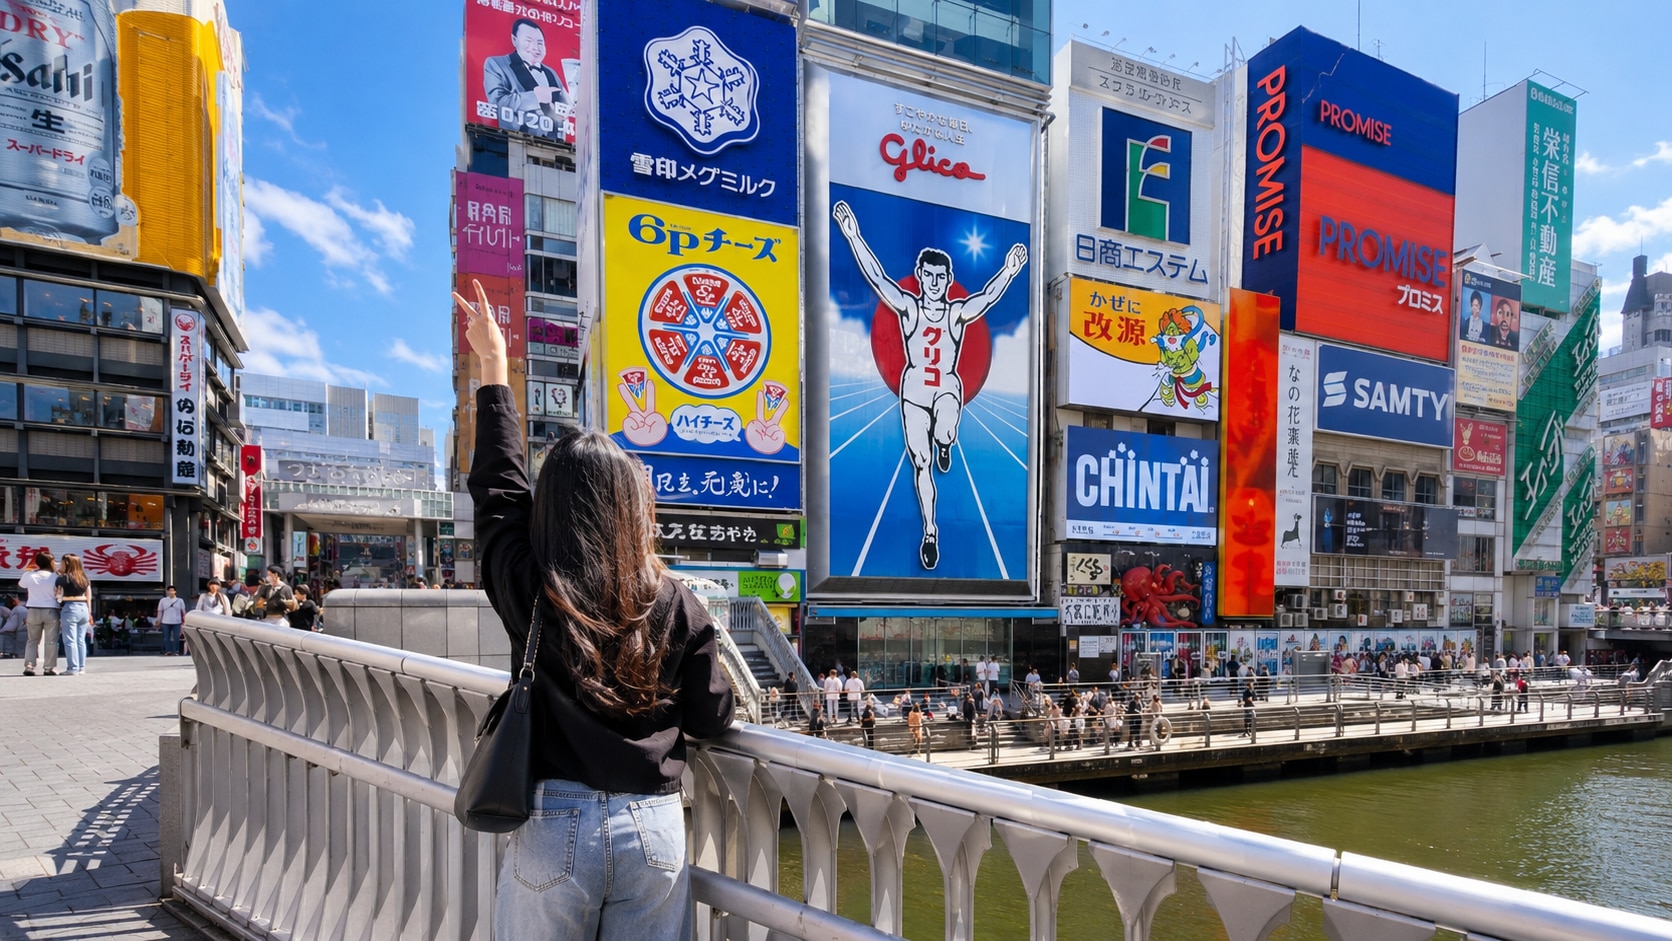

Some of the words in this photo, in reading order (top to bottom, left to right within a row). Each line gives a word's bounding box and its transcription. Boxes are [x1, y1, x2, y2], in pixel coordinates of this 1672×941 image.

[0, 10, 74, 50] DRY
[31, 108, 65, 134] 生
[1320, 99, 1392, 147] PROMISE
[6, 138, 86, 166] スーパードライ
[879, 133, 986, 182] Glico
[1253, 64, 1286, 260] PROMISE
[630, 152, 776, 198] 雪印メグミルク
[1076, 234, 1209, 285] 日商エステム
[1319, 215, 1448, 288] PROMISE
[1089, 291, 1141, 315] かぜに
[1397, 284, 1444, 315] プロミス
[1083, 311, 1147, 347] 改源
[922, 325, 946, 387] グリコ
[1354, 377, 1449, 421] SAMTY
[676, 414, 735, 431] ハイチーズ
